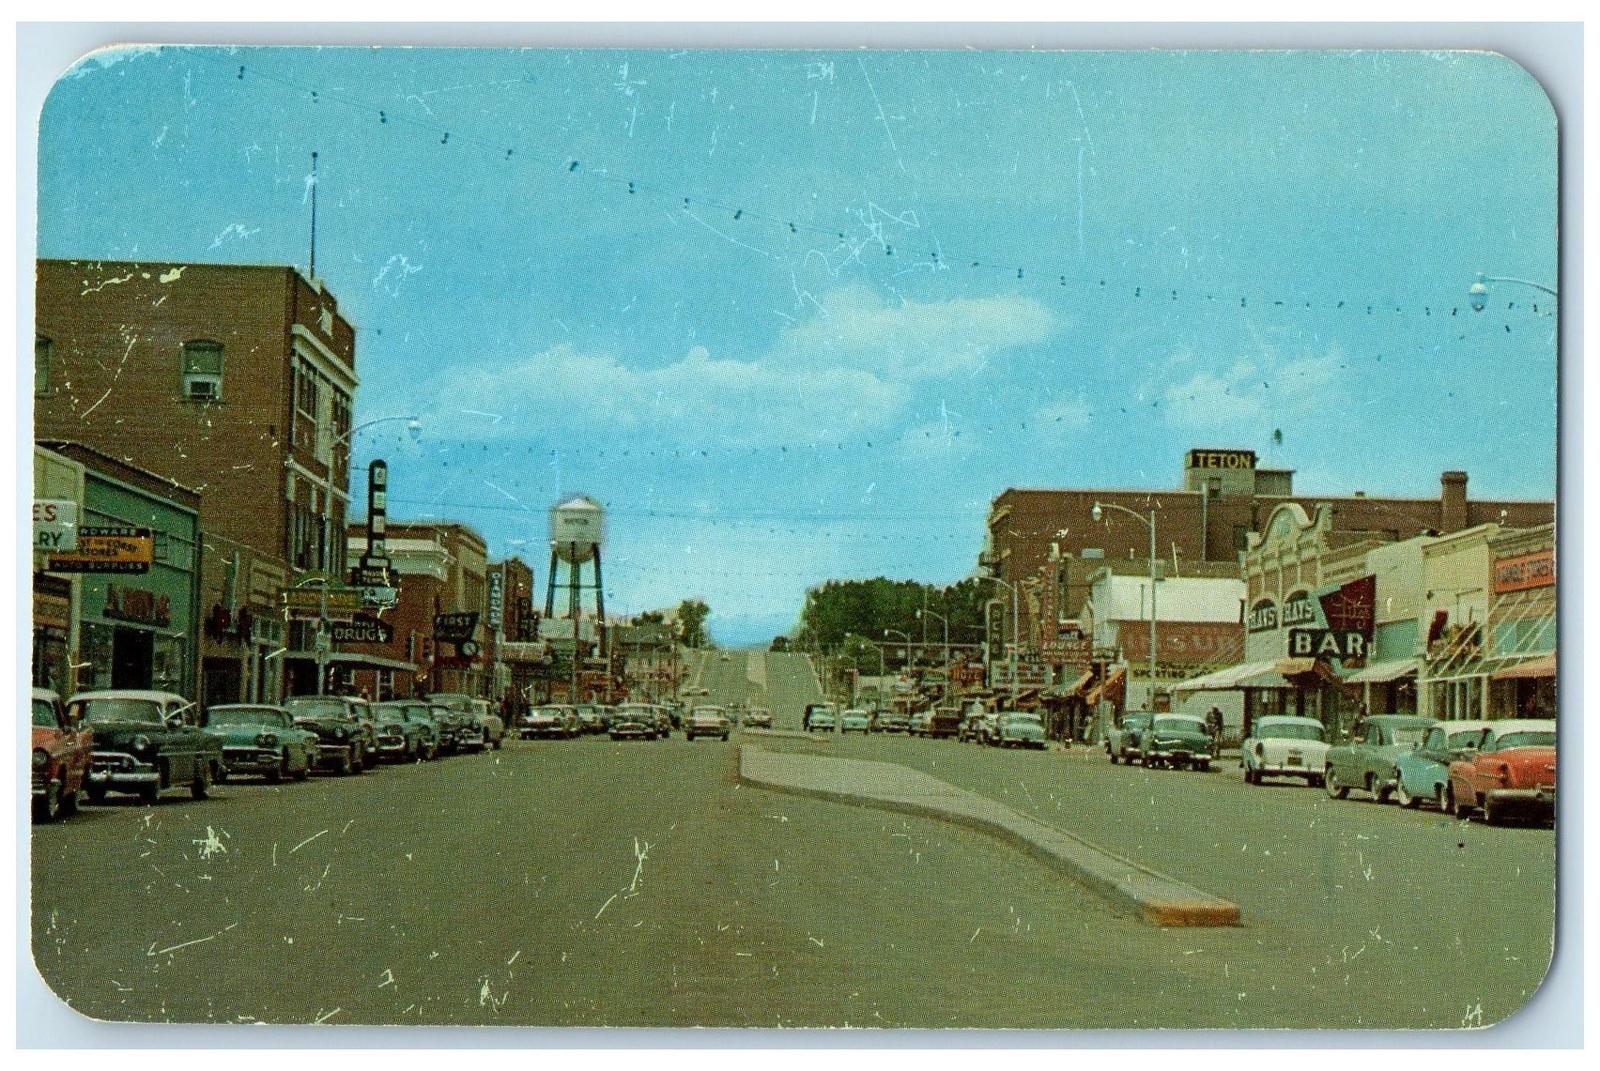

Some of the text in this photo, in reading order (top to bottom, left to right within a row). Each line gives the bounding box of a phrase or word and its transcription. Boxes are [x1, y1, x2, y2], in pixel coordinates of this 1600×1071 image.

[1196, 452, 1252, 470] TETON
[436, 615, 470, 627] FIRST
[1295, 632, 1363, 656] BAR
